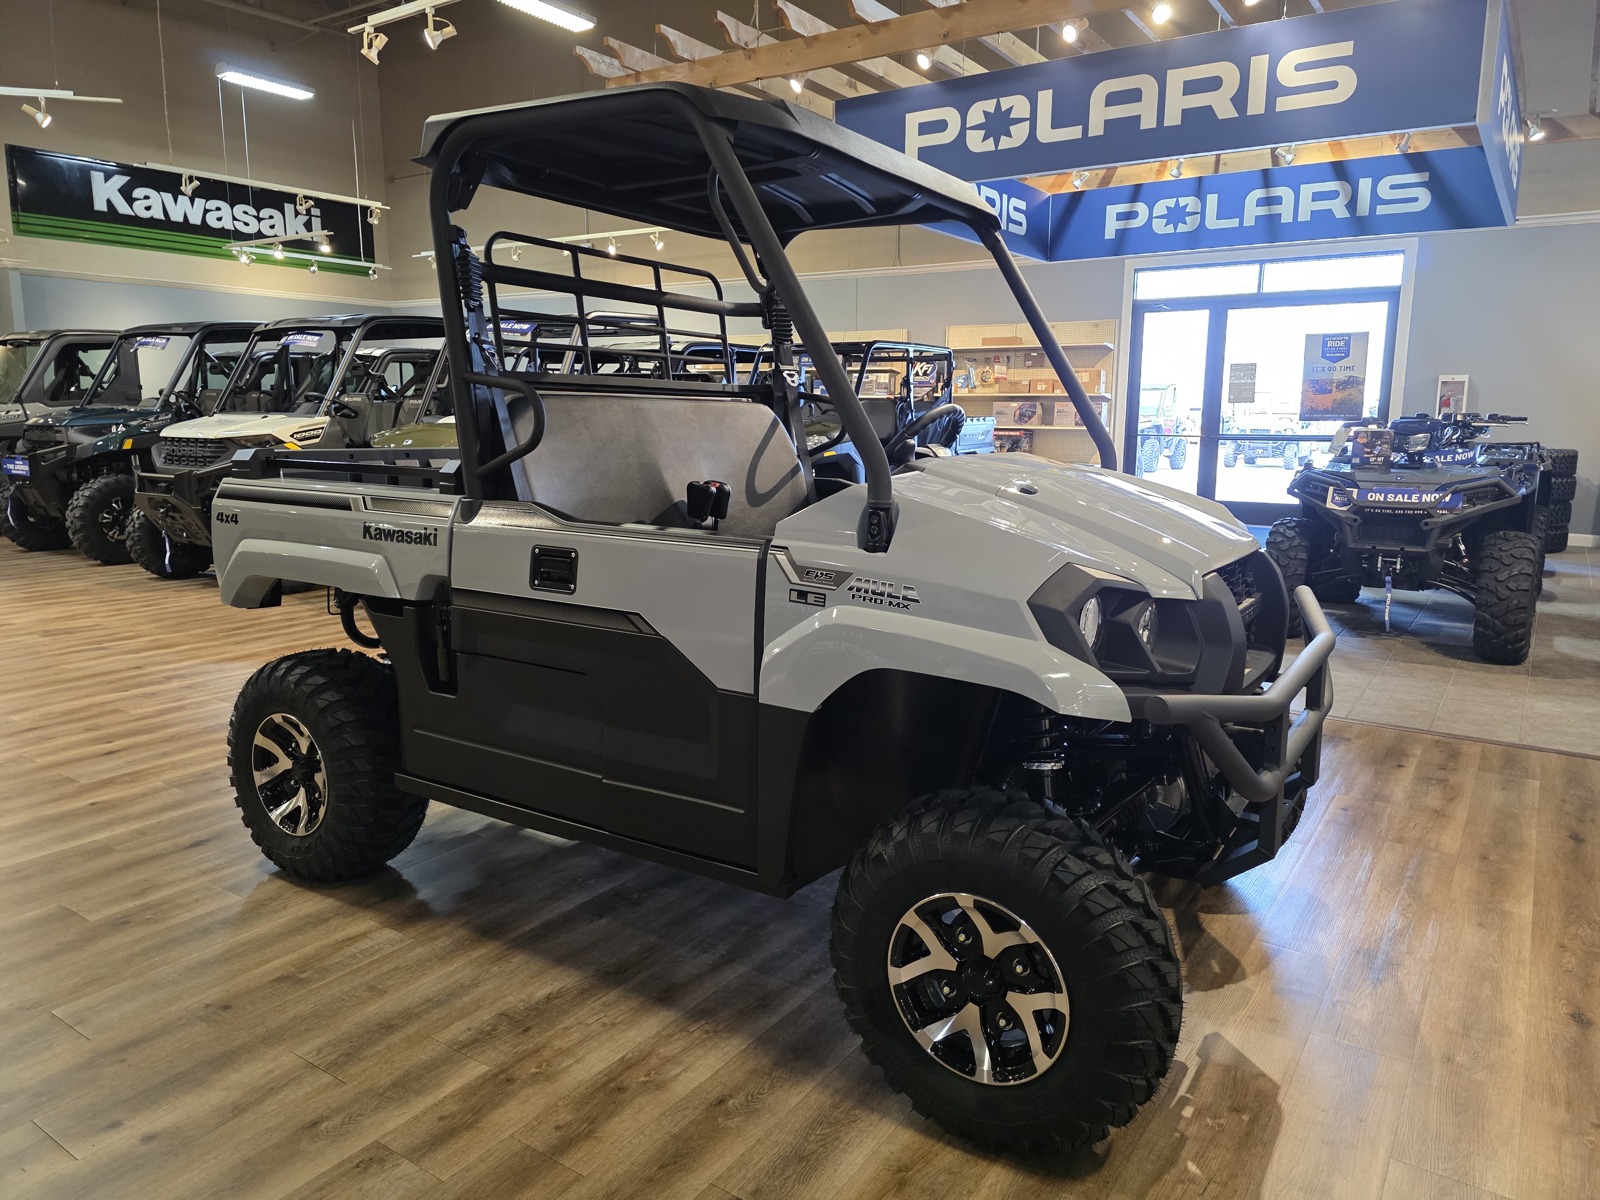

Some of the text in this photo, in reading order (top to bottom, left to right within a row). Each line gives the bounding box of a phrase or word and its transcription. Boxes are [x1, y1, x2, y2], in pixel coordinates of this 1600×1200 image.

[904, 40, 1358, 160] POLARIS
[91, 171, 322, 242] Kawasaki
[1104, 172, 1432, 240] POLARIS
[1435, 450, 1475, 463] ALE NOW
[1367, 492, 1385, 502] ON
[1386, 493, 1420, 503] SALE
[216, 512, 239, 525] 4x4
[362, 521, 438, 547] Kawasaki
[789, 588, 826, 607] LE
[846, 577, 921, 604] MULE
[851, 593, 912, 611] PRO-MX
